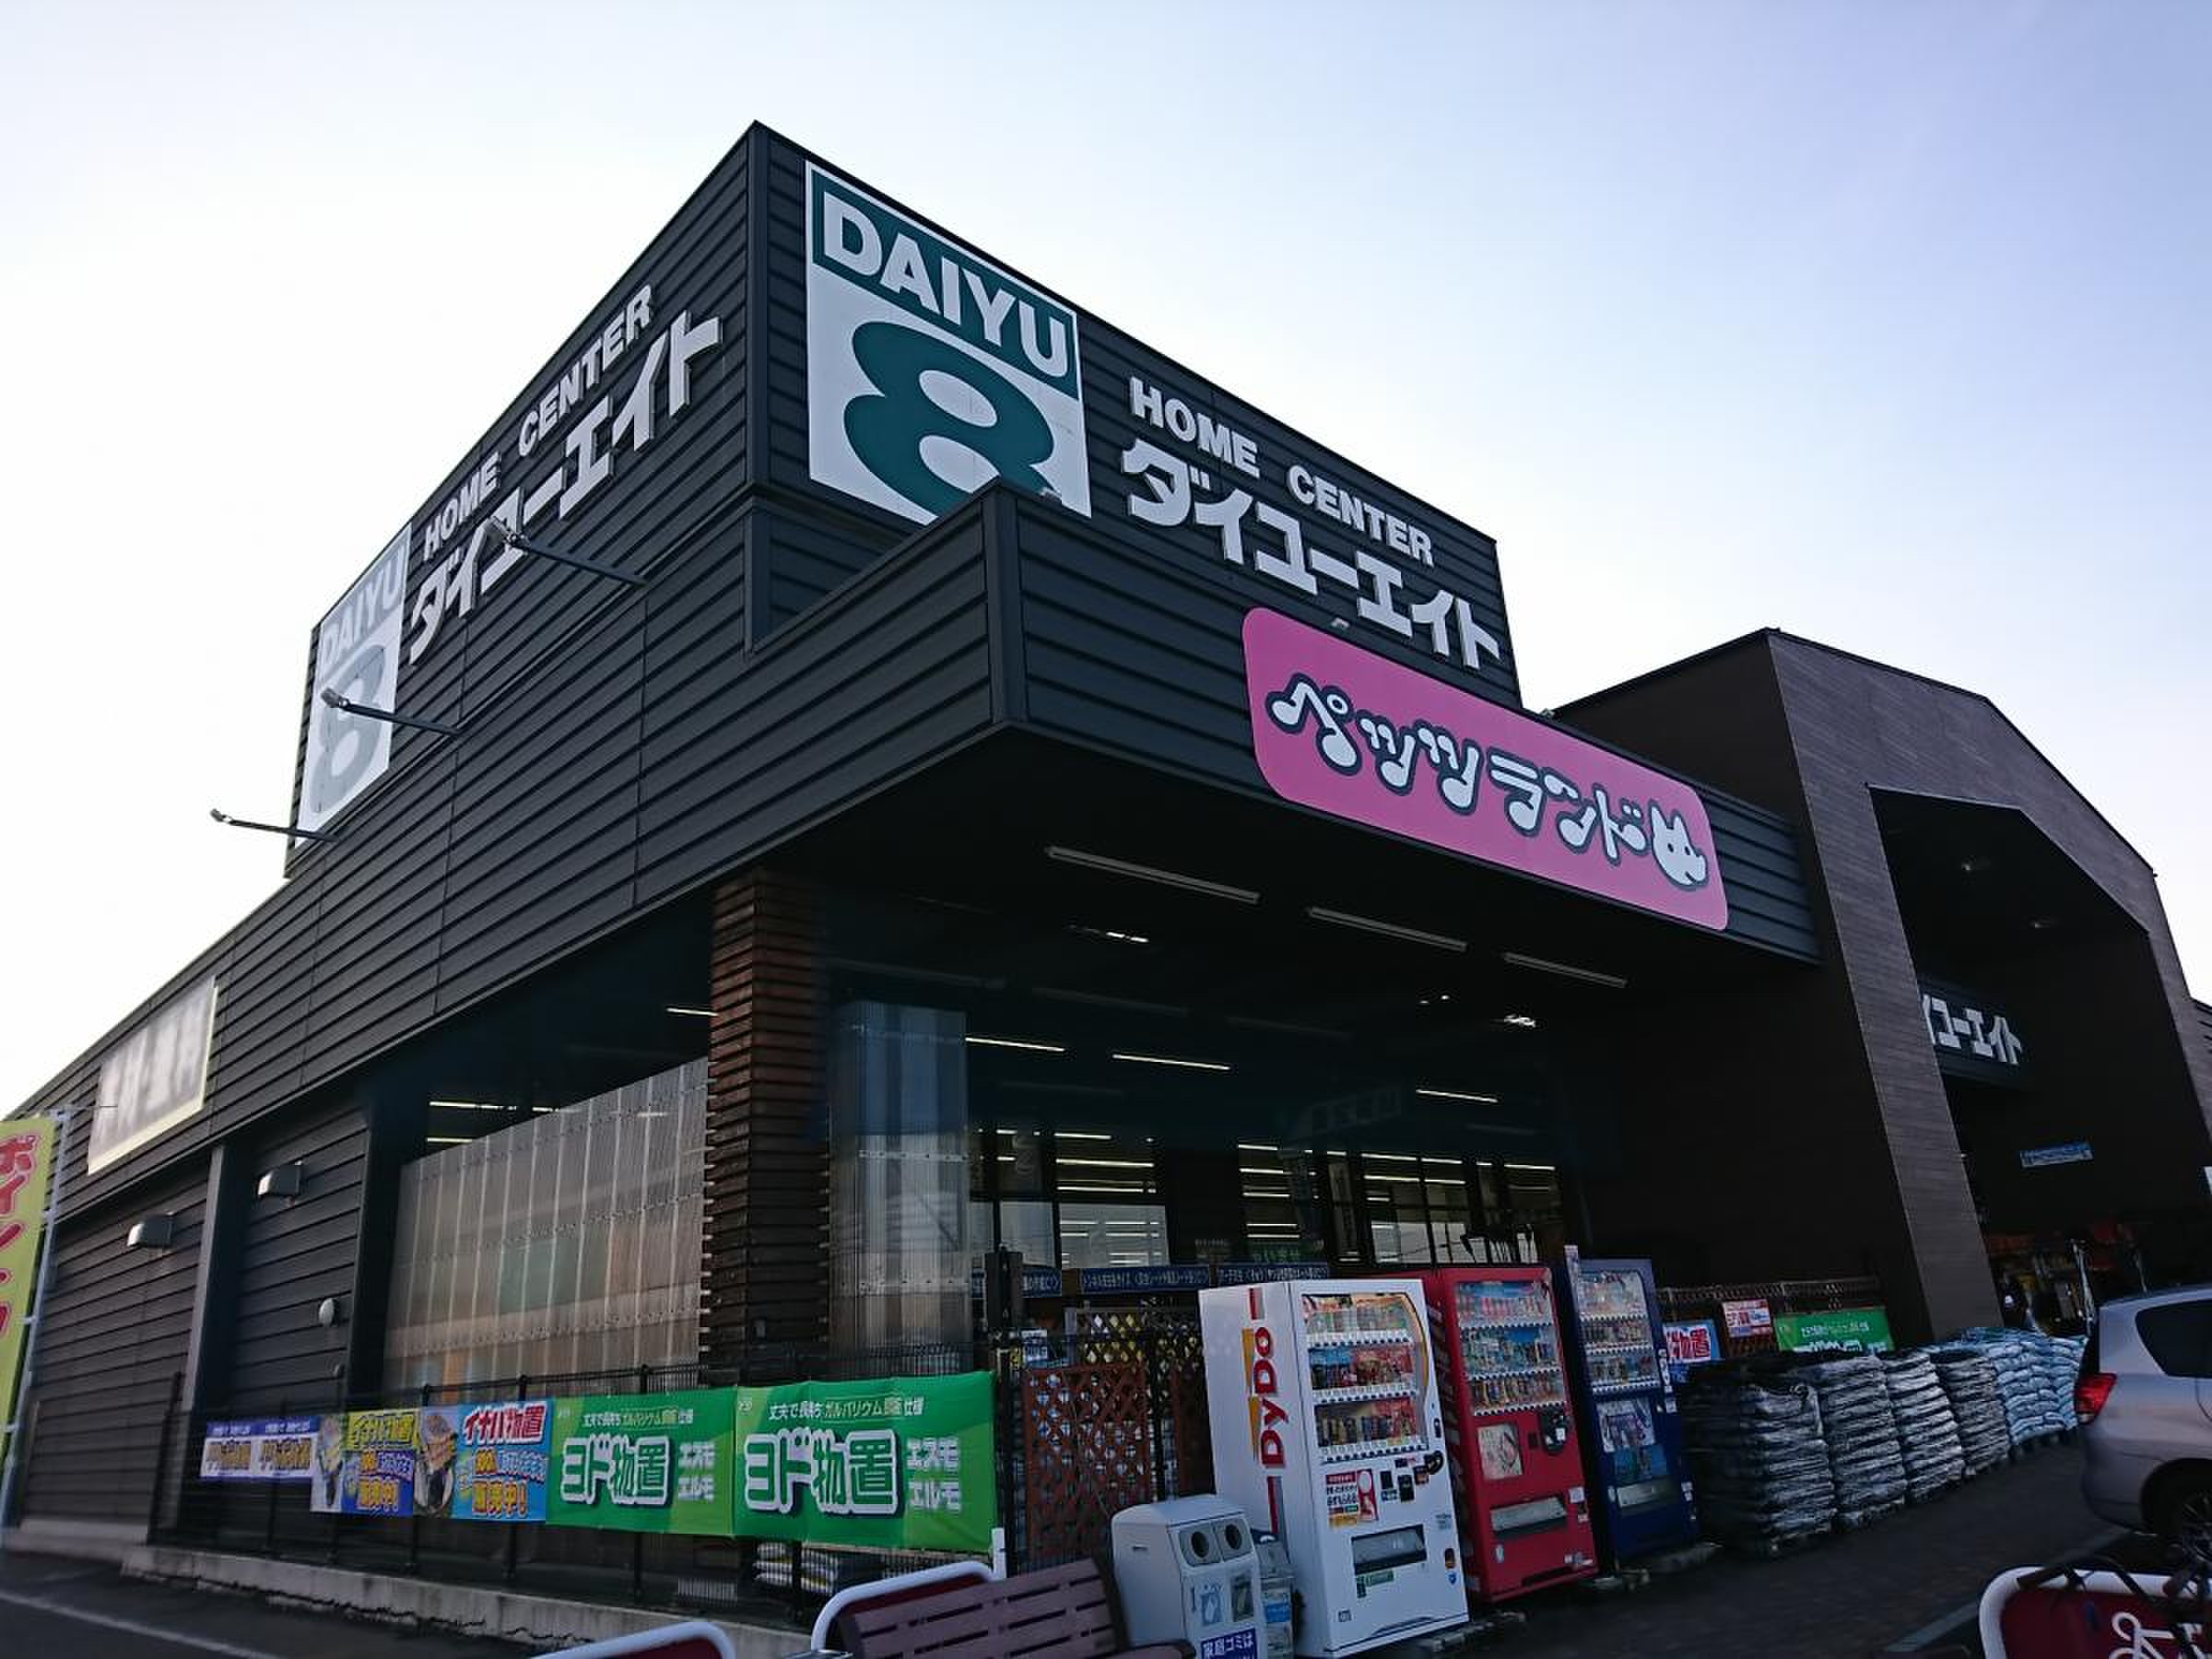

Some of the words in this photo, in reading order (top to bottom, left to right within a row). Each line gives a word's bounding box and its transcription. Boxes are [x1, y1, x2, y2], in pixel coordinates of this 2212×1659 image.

[823, 190, 1070, 379] DAIYU
[410, 309, 723, 665] ダイユーエイト
[423, 451, 502, 561] HOME
[518, 284, 653, 458] CENTER
[843, 320, 1056, 523] 8
[1129, 377, 1260, 478] HOME
[1288, 465, 1433, 566] CENTER
[322, 544, 404, 676] DAIYU
[1122, 439, 1501, 670] ダイユーエイト
[309, 643, 385, 814] 8
[1266, 674, 1650, 865] ペッツランド
[561, 1433, 670, 1505] ヨド物置
[744, 1427, 900, 1514] ヨド物置
